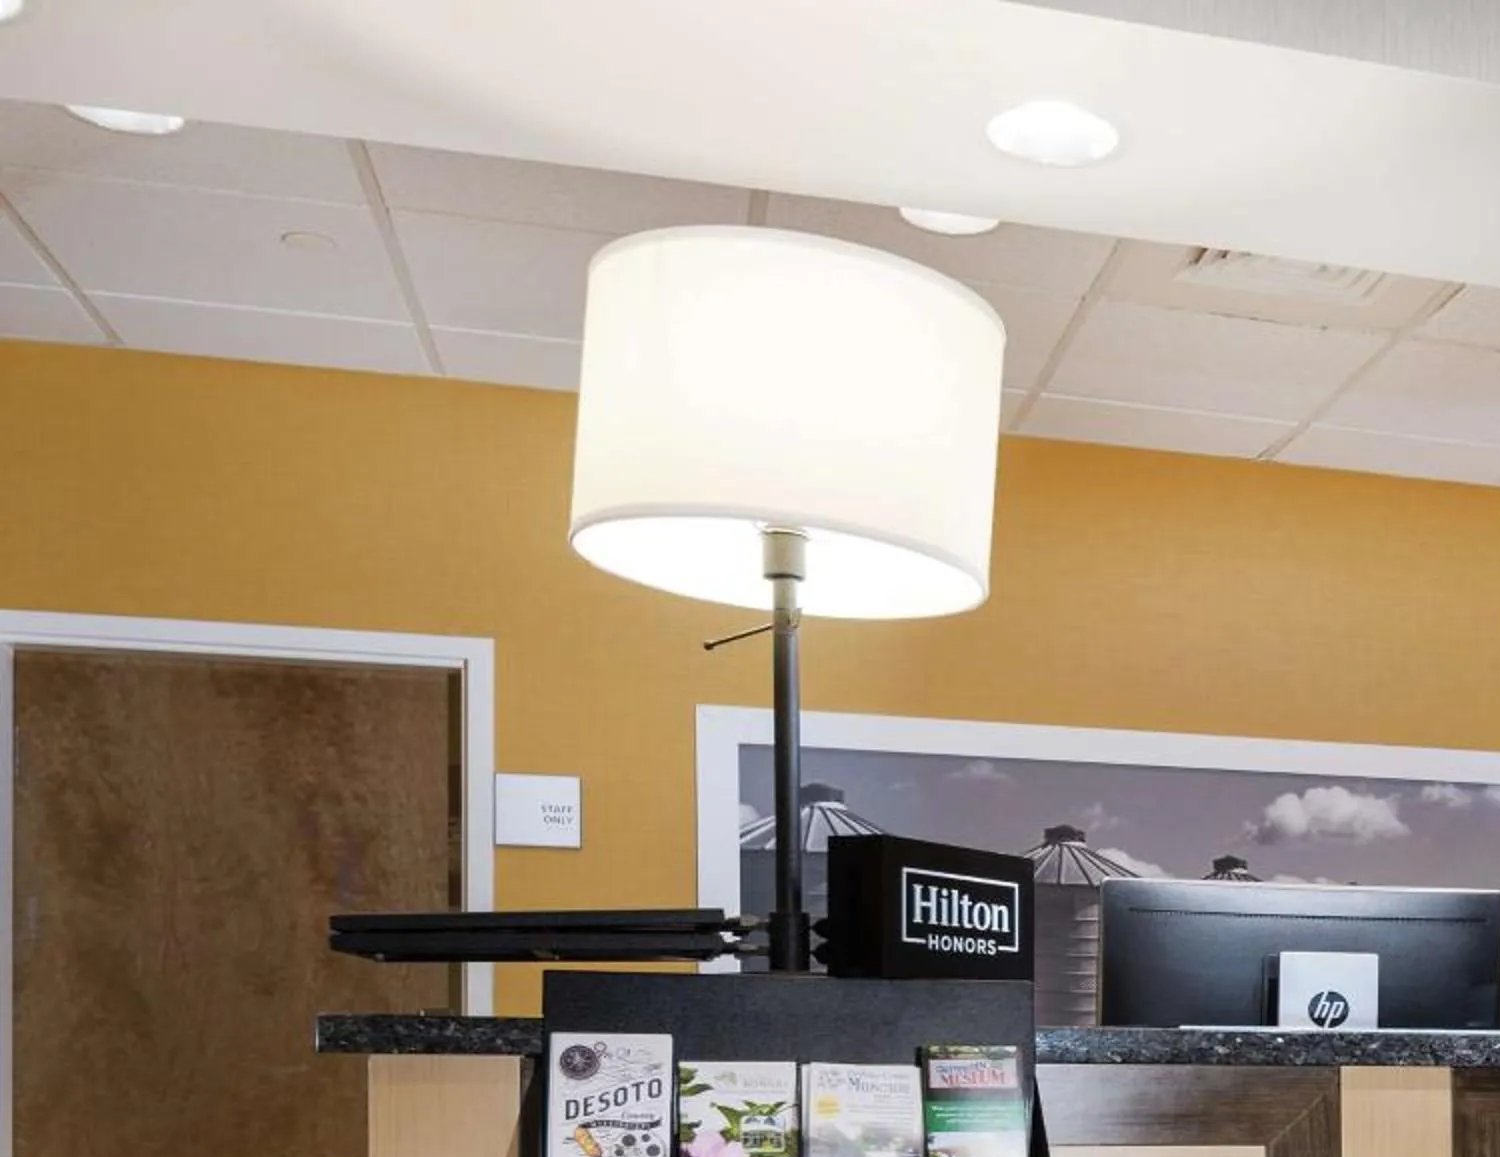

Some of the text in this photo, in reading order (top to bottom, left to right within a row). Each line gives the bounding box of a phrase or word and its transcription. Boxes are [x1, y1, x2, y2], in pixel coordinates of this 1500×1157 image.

[541, 805, 573, 813] STAFF
[543, 815, 573, 825] ONLY
[912, 884, 1010, 933] Hilton
[927, 934, 997, 956] HONORS
[1311, 991, 1347, 1028] hp
[565, 1078, 662, 1120] DESOTO
